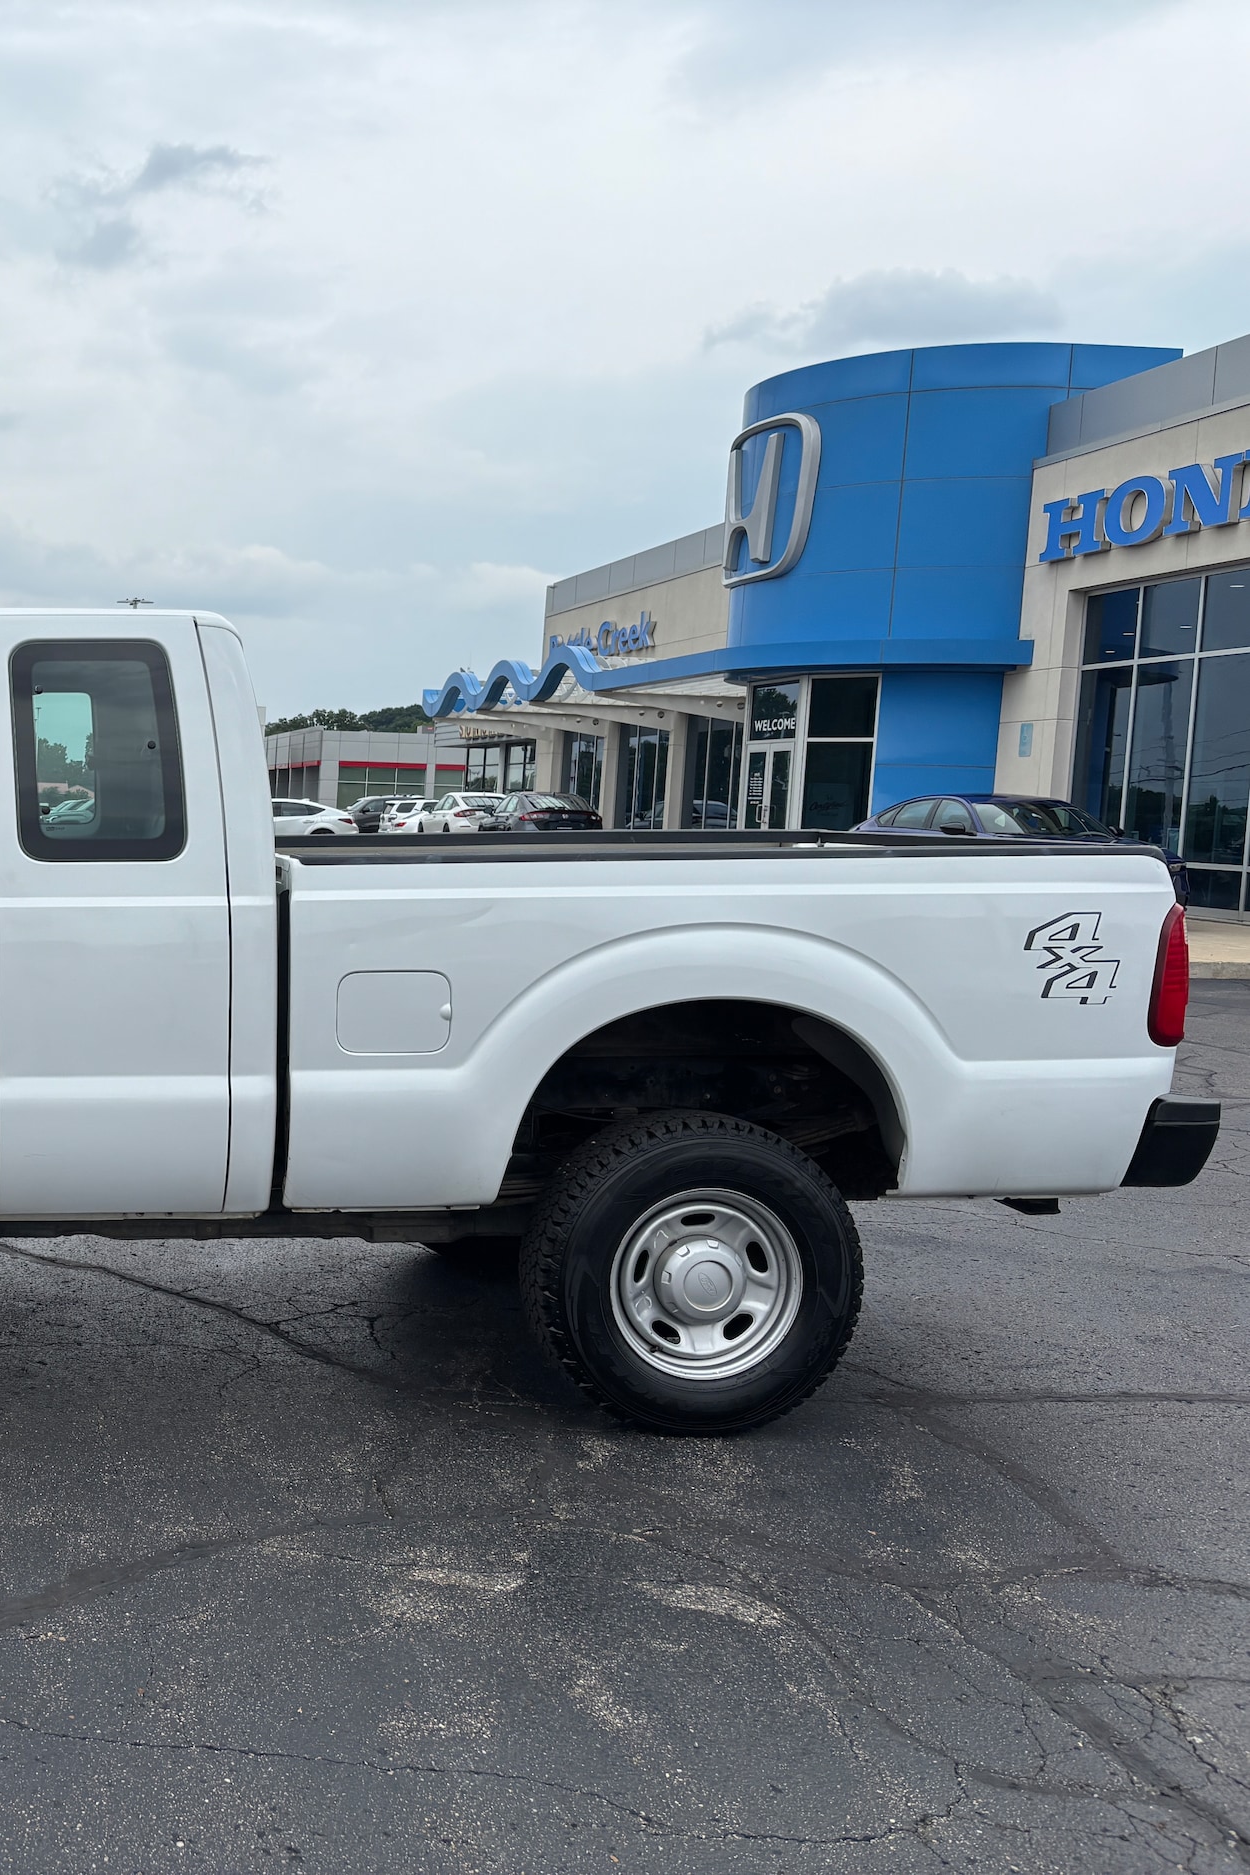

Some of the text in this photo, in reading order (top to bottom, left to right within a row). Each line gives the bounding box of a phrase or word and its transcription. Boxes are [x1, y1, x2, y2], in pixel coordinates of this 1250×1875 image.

[1039, 450, 1250, 563] HON
[597, 610, 656, 657] Creek
[754, 717, 796, 732] WELCOME
